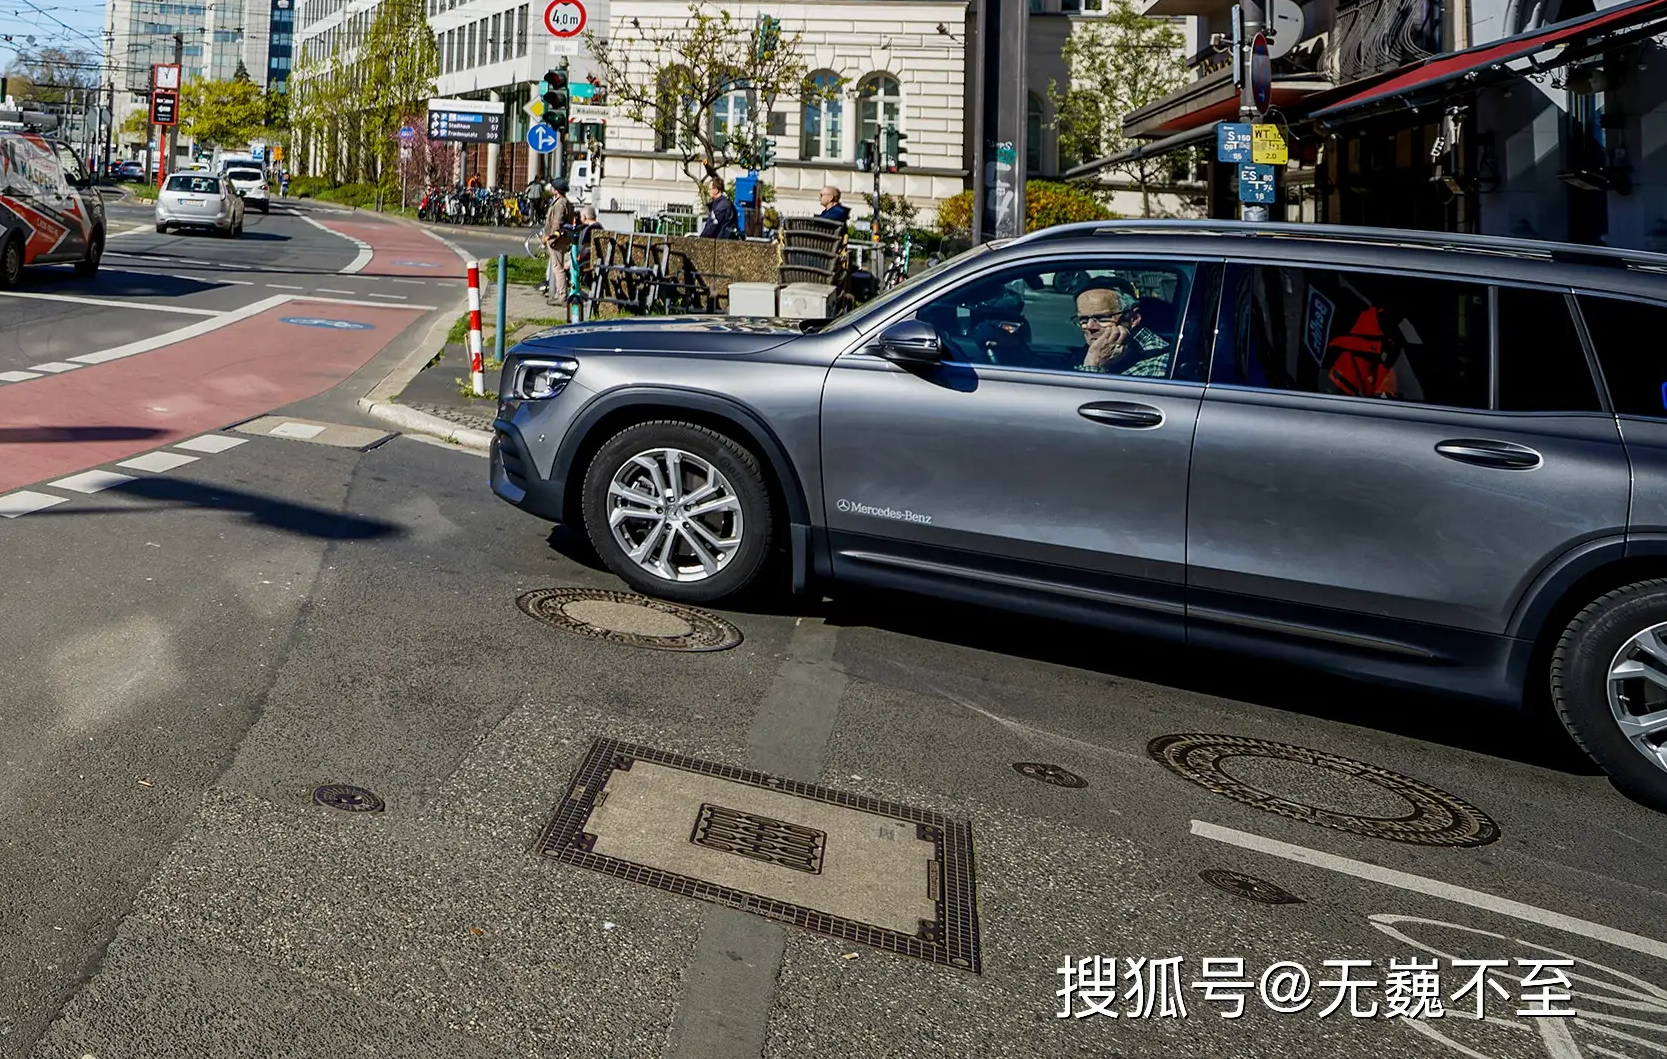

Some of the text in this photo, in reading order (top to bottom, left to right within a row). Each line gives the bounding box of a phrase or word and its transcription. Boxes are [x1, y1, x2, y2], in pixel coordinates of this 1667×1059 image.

[569, 16, 579, 25] m
[1227, 131, 1235, 141] S
[1254, 129, 1270, 139] WT
[1241, 170, 1257, 181] ES
[850, 501, 932, 524] Mercedes-Benz
